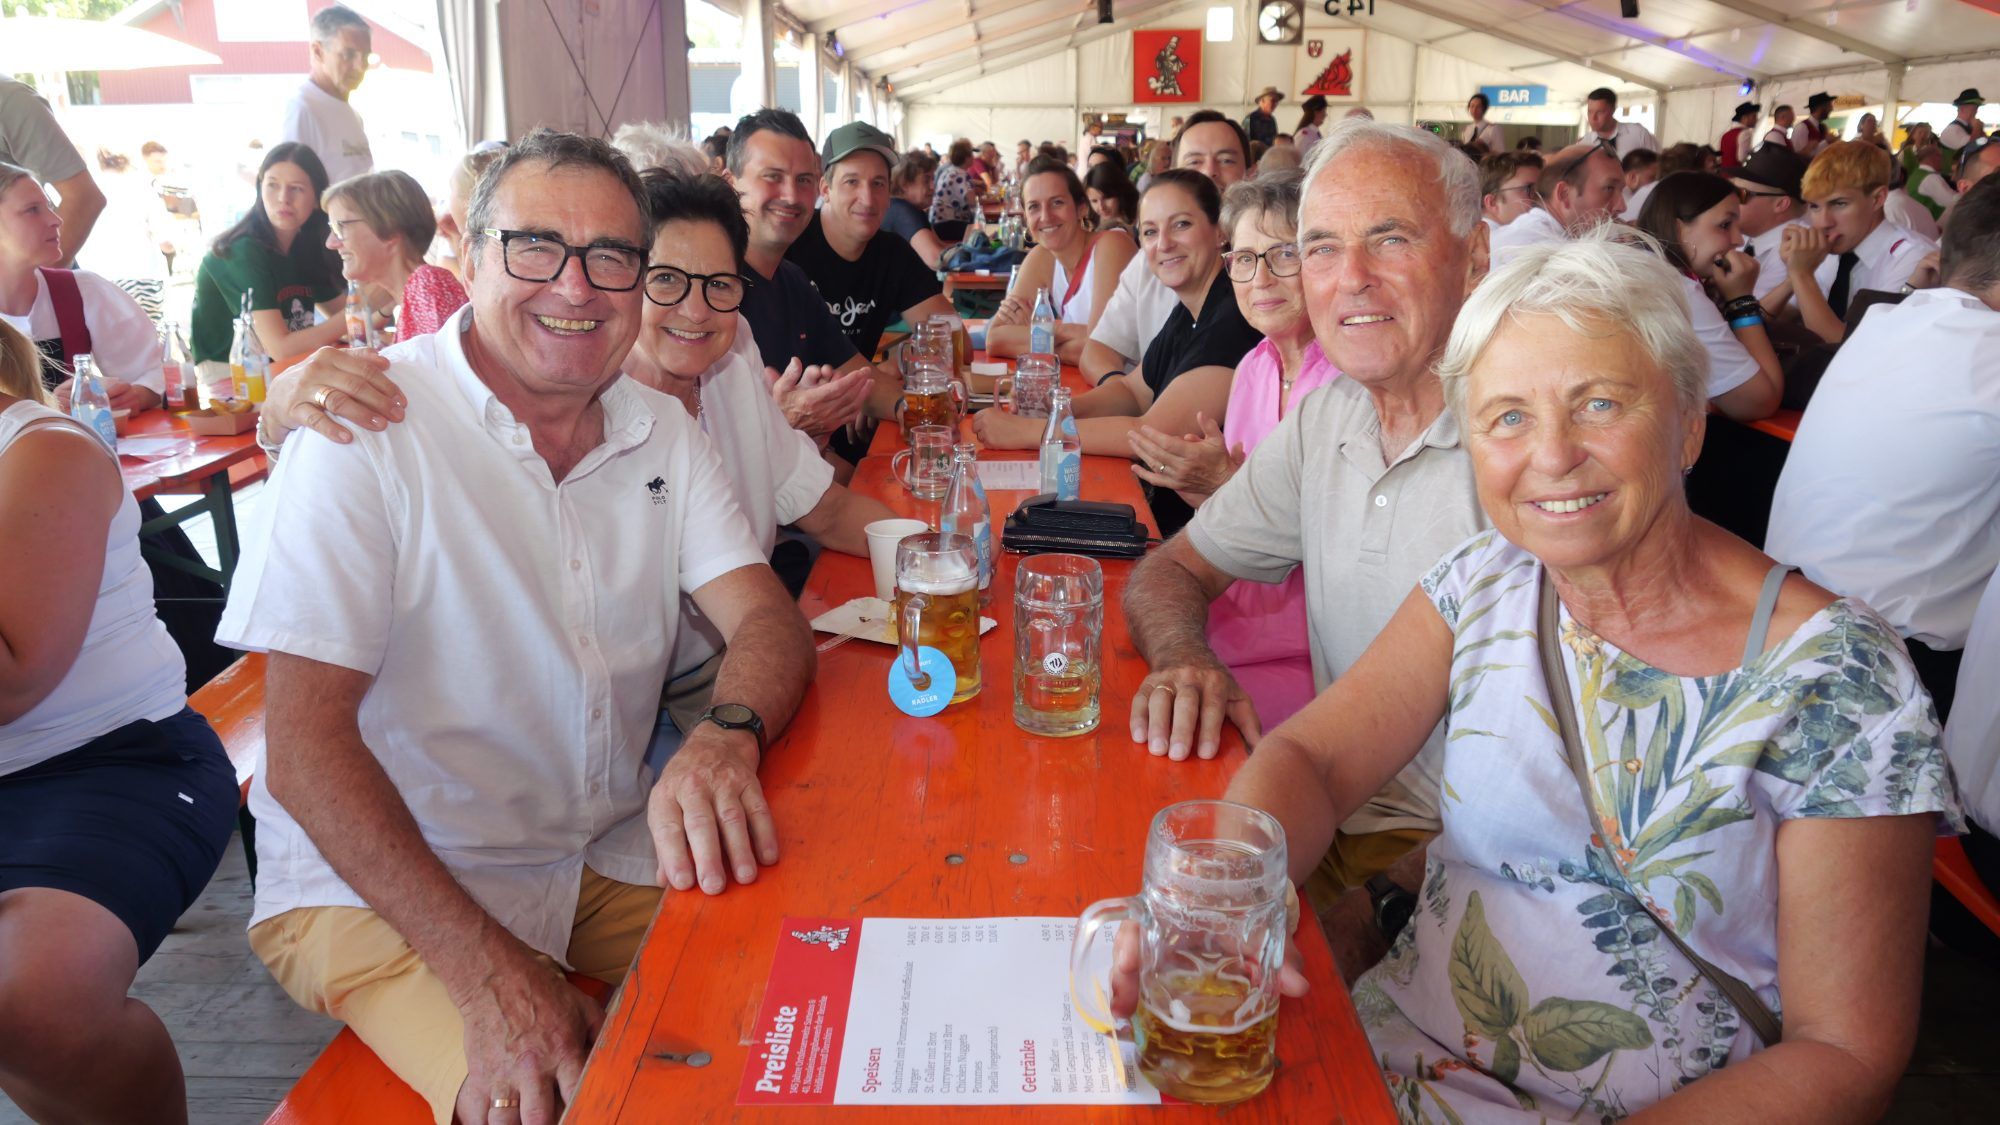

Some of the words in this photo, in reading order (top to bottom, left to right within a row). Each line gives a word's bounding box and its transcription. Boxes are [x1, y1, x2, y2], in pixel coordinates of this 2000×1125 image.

[1498, 89, 1530, 103] BAR
[911, 695, 938, 706] RADLER
[900, 1001, 909, 1016] oder
[1062, 1002, 1071, 1022] Sauer
[897, 1017, 908, 1046] Pommes
[927, 1032, 937, 1046] Brot
[943, 1024, 953, 1038] Brot
[755, 1006, 798, 1093] Preisliste
[897, 1047, 906, 1059] mit
[927, 1047, 936, 1059] mit
[942, 1039, 952, 1051] mit
[957, 1034, 970, 1062] Nuggets
[988, 1026, 1001, 1070] (vegetarisch)
[862, 1048, 881, 1093] Speisen
[925, 1061, 936, 1083] Galler
[1019, 1040, 1037, 1092] Getränke
[1050, 1049, 1060, 1073] Radler
[892, 1060, 904, 1093] Schnitzel
[907, 1068, 921, 1094] Burger
[940, 1052, 953, 1094] Currywurst
[956, 1064, 967, 1094] Chicken
[972, 1061, 983, 1094] Pommes
[988, 1071, 999, 1094] Paella
[1068, 1074, 1078, 1093] Wein
[1083, 1075, 1094, 1093] Most
[1099, 1075, 1110, 1093] Limo
[1126, 1065, 1137, 1093] Mineral
[924, 1084, 935, 1094] St.
[1051, 1077, 1062, 1093] Bier
